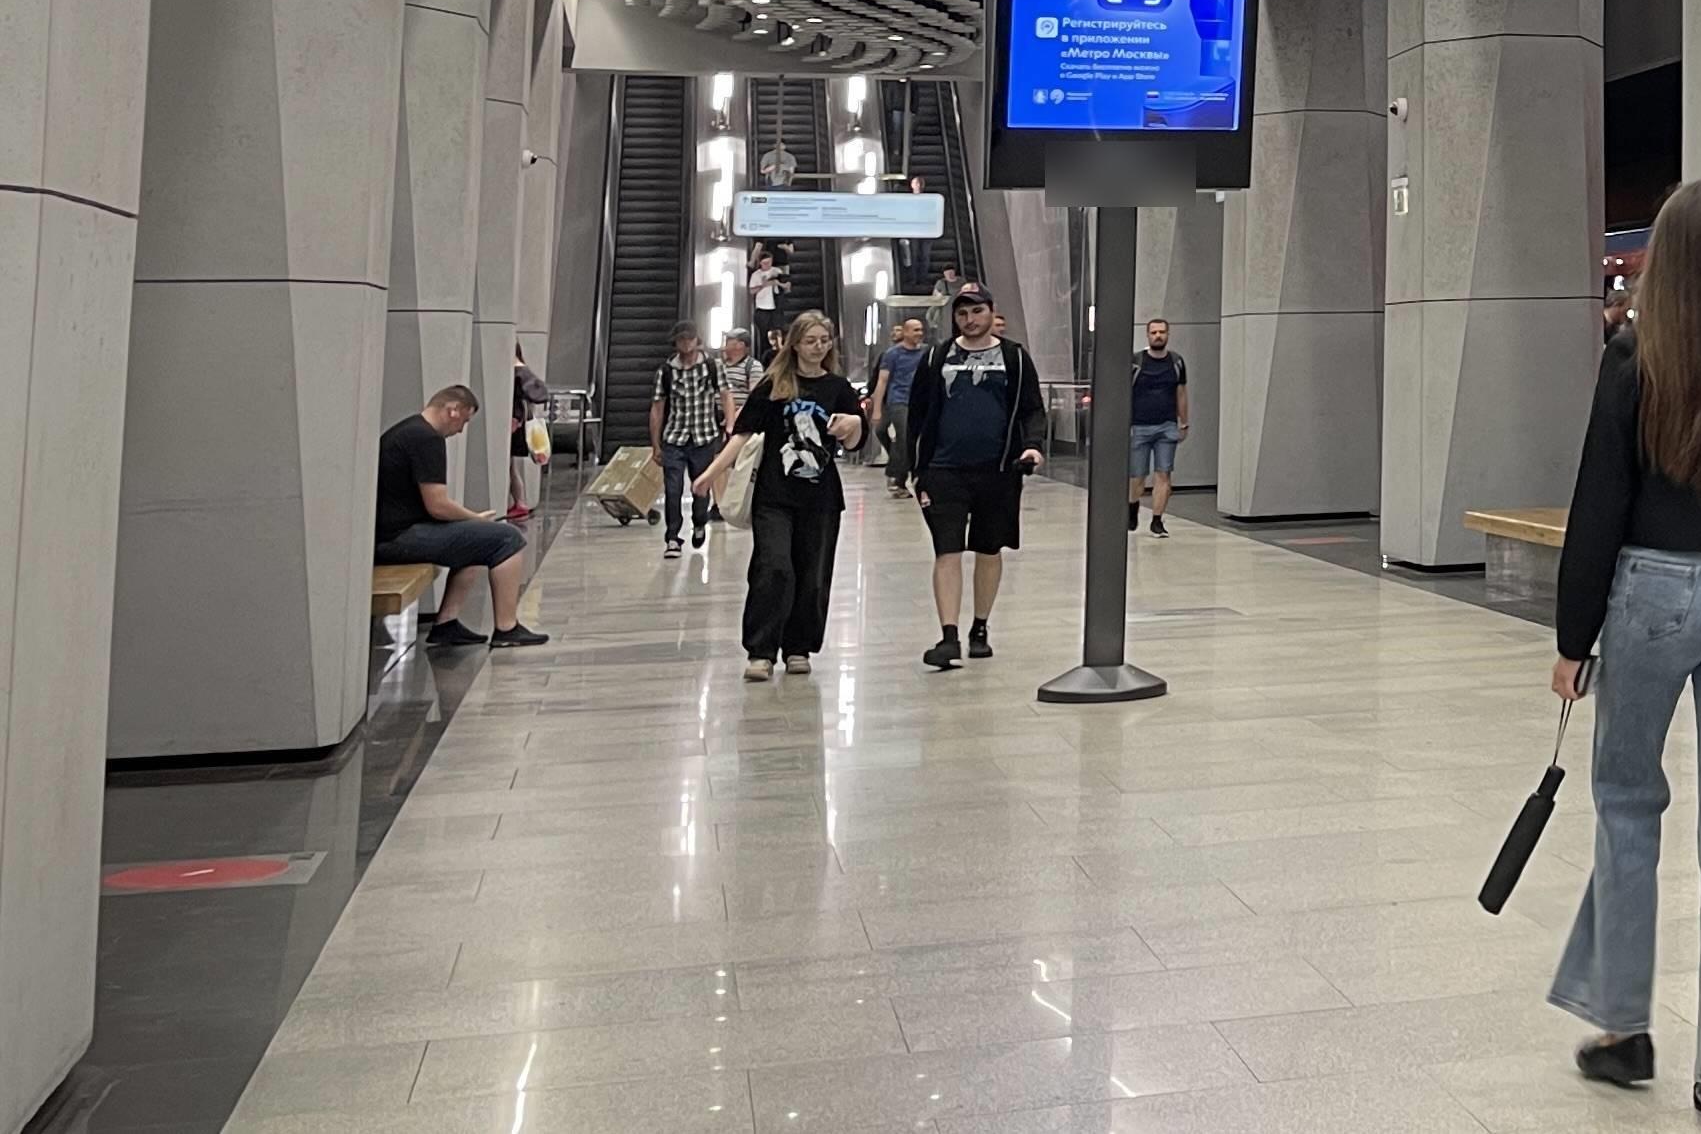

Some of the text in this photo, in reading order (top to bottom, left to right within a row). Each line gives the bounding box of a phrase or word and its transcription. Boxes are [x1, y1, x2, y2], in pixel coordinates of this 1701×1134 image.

[1062, 17, 1167, 32] Регистрируйтесь
[1061, 34, 1150, 45] в приложении
